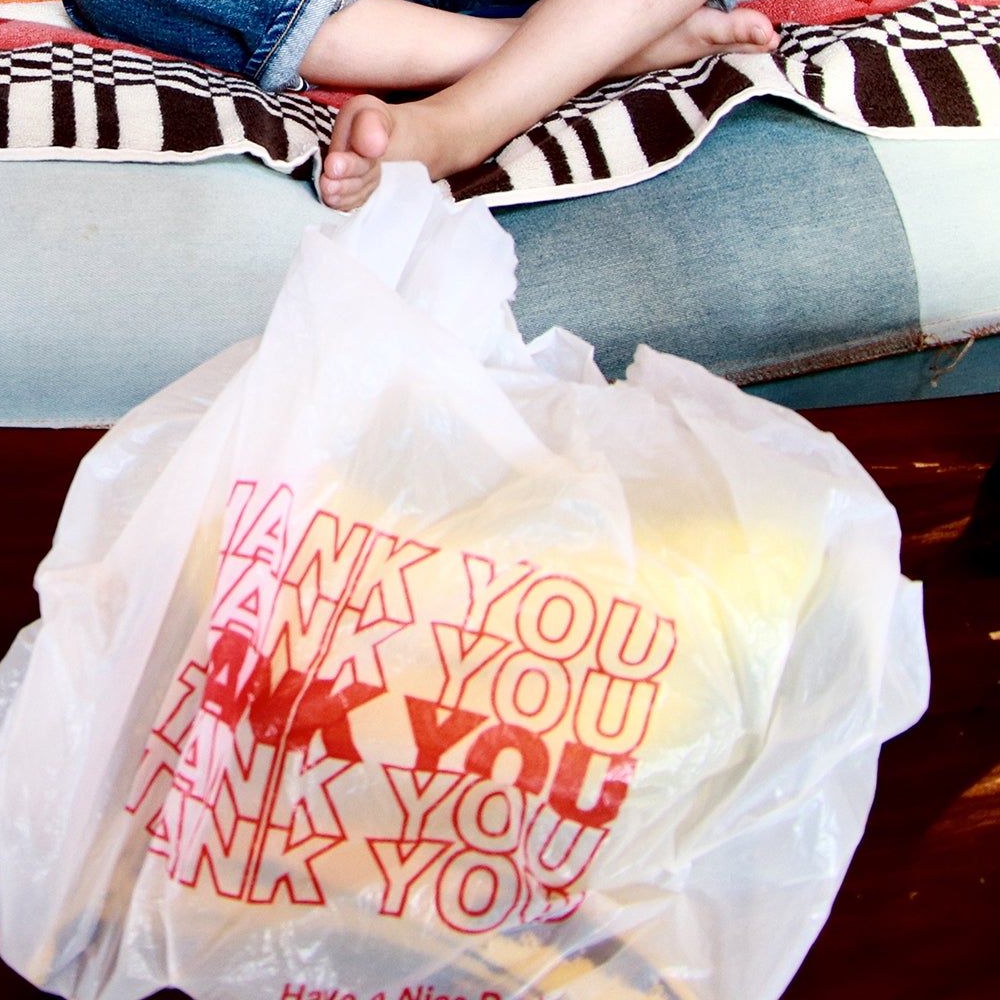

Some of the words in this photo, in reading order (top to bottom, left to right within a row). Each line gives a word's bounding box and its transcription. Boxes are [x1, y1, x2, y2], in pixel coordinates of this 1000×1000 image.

[209, 561, 415, 692] ANK
[431, 620, 661, 756] YOU
[221, 479, 441, 625] ANK
[462, 551, 677, 682] YOU
[201, 631, 388, 763] ANK
[404, 694, 638, 828] YOU
[381, 763, 610, 891] YOU
